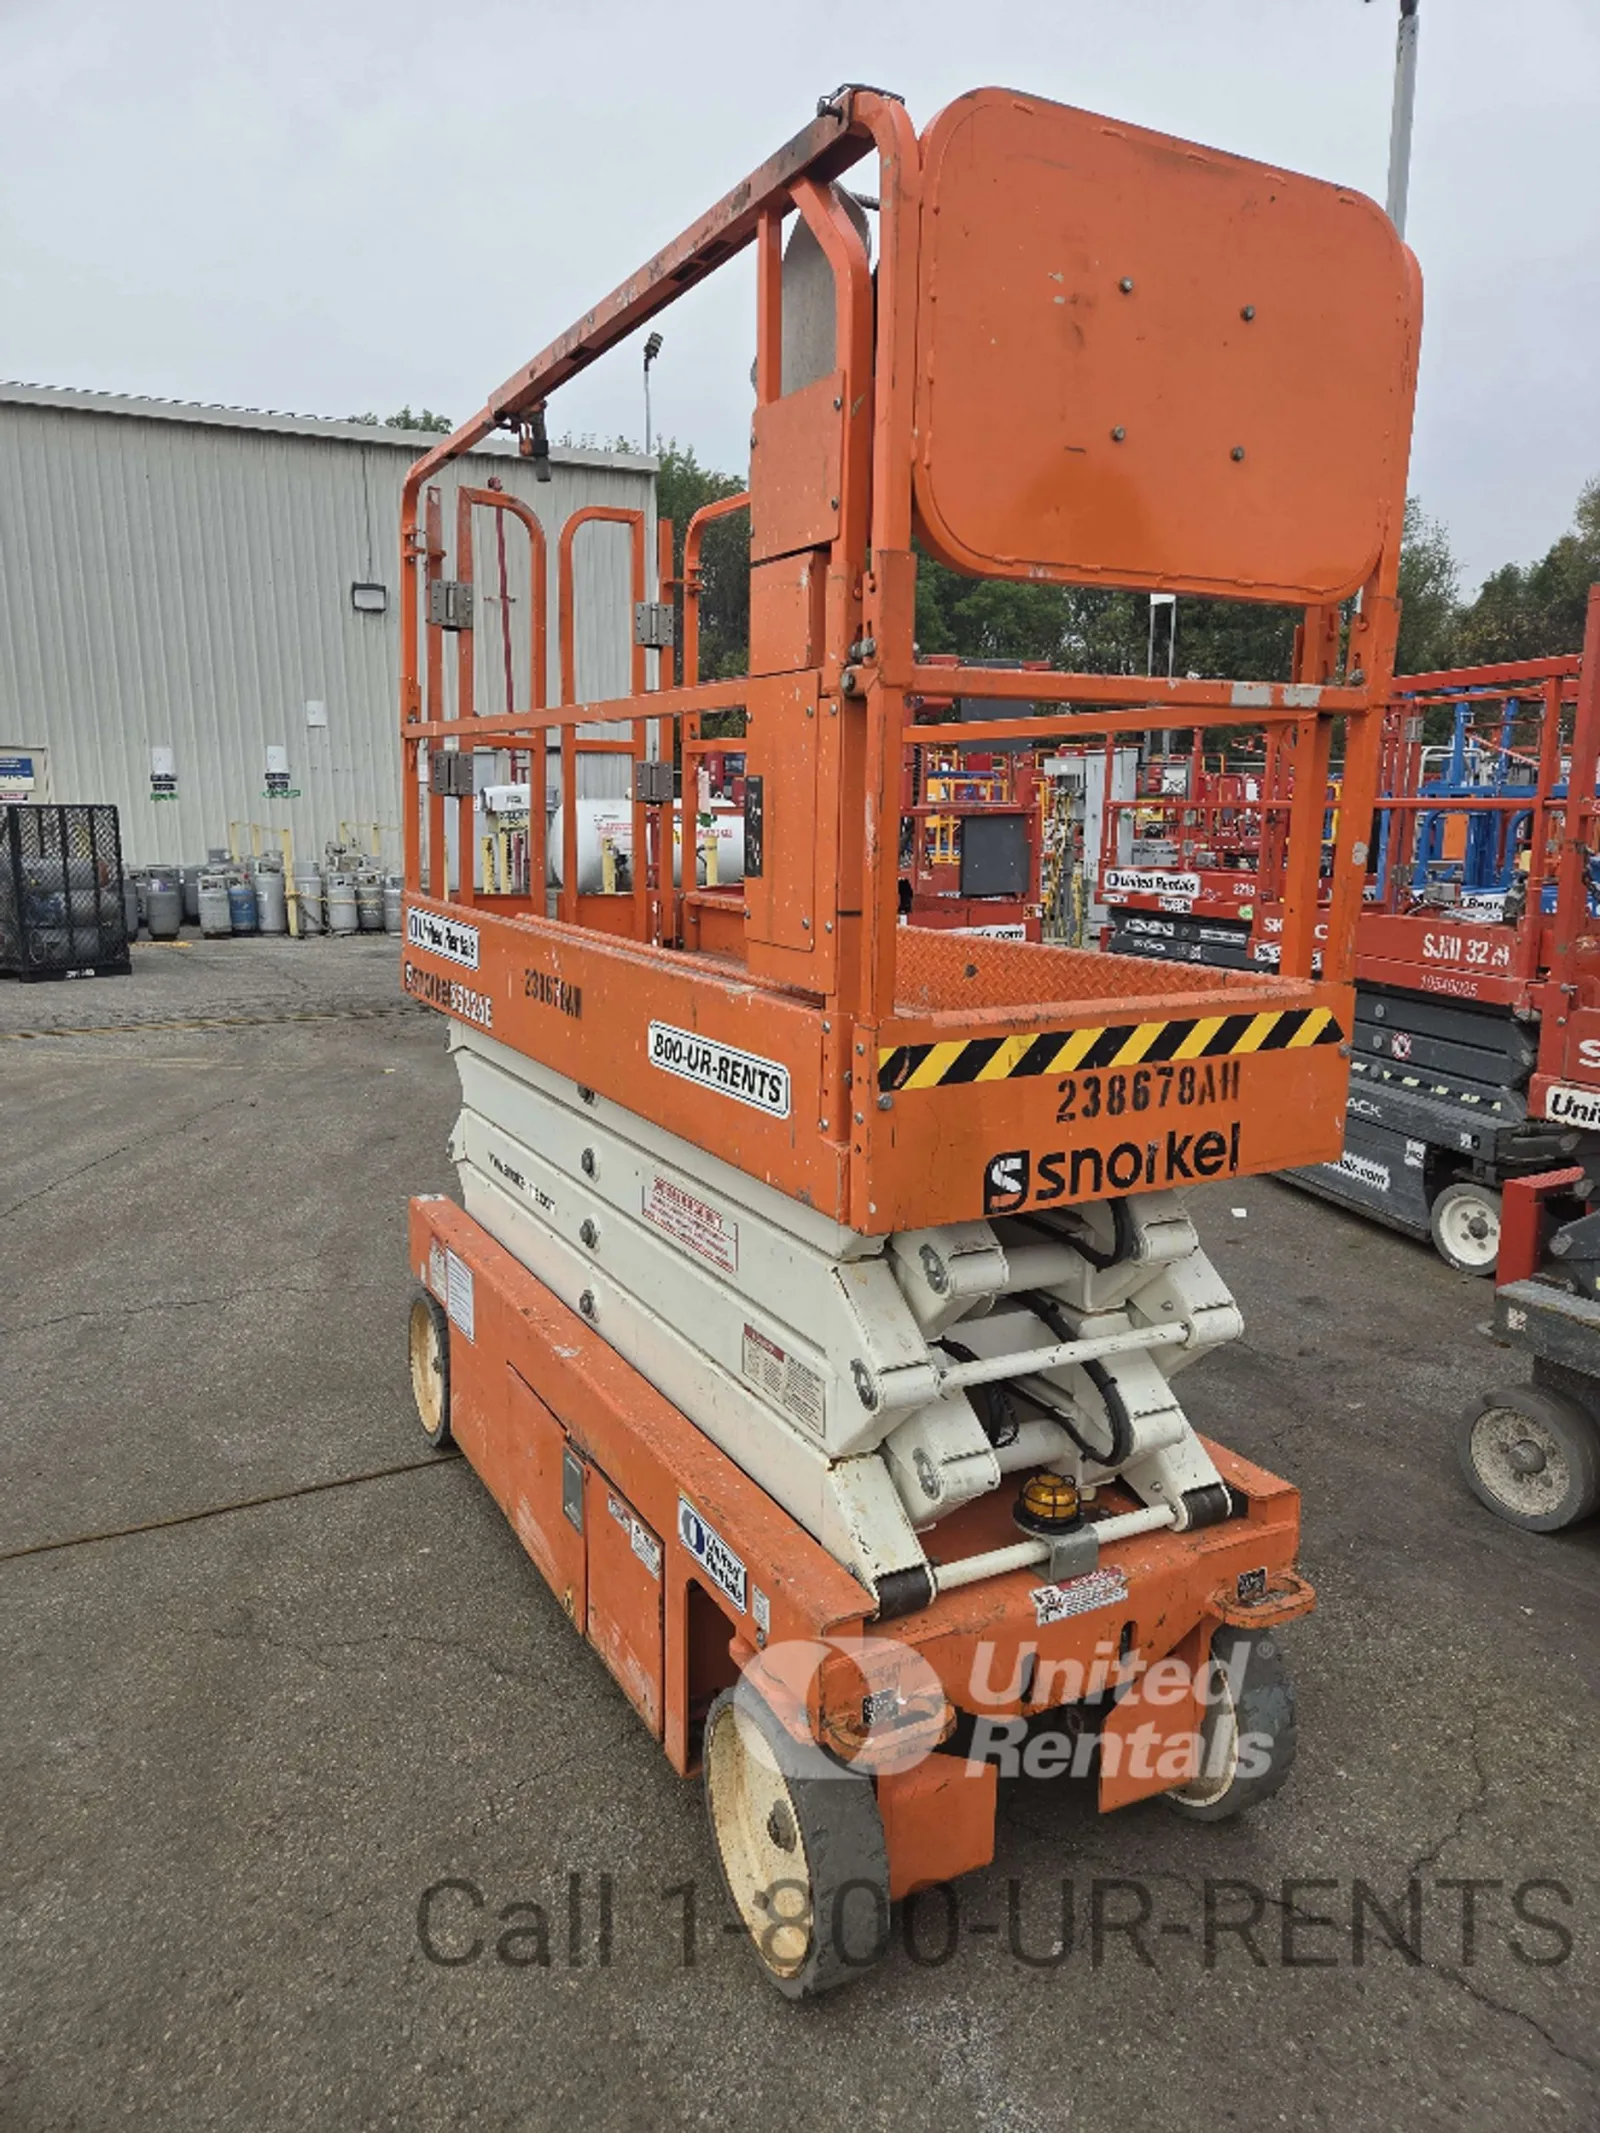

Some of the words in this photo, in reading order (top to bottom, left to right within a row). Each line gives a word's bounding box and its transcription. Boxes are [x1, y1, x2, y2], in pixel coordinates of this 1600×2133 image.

[1120, 873, 1153, 888] United
[653, 1033, 783, 1103] 800-UR-RENTS
[1056, 1060, 1240, 1124] 238678AH
[1035, 1121, 1241, 1201] snorkel
[706, 1534, 741, 1582] United
